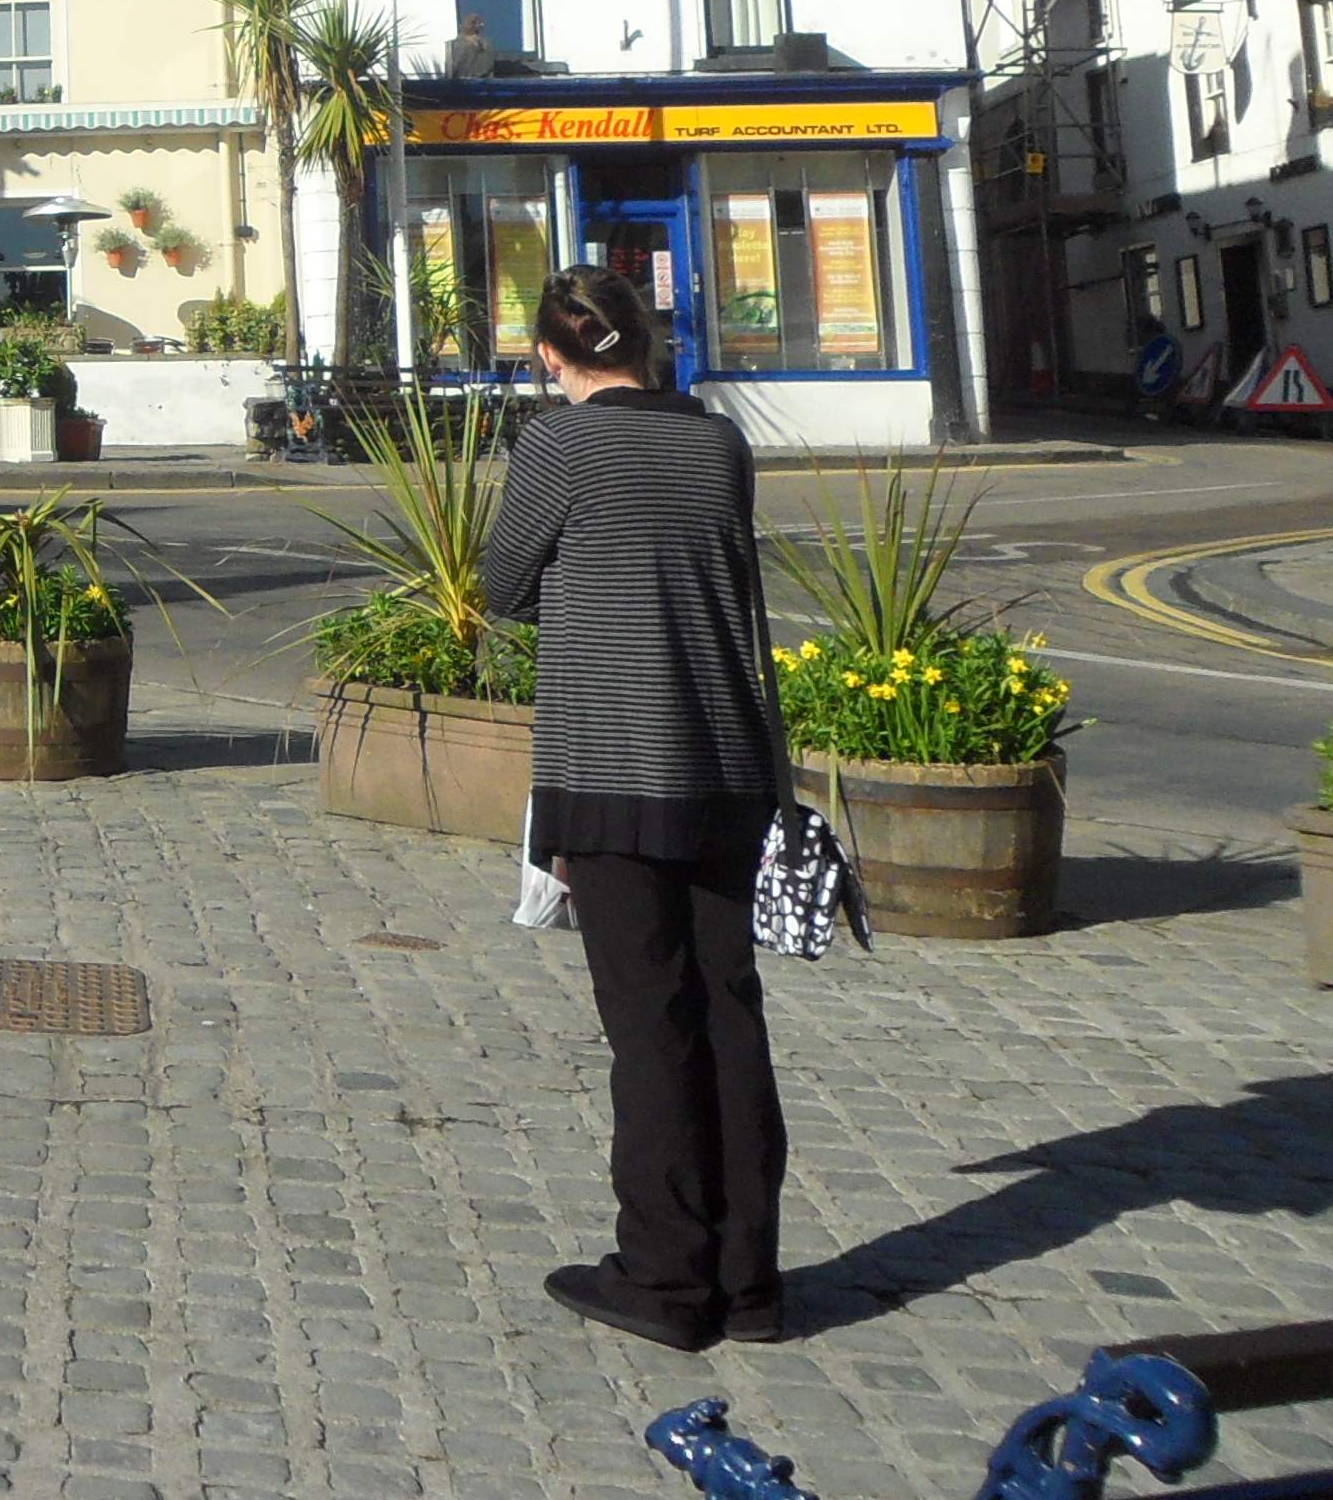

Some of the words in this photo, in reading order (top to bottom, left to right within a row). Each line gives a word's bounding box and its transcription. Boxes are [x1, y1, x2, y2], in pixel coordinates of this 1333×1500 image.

[441, 110, 523, 140] Chas.
[536, 108, 656, 140] Kendall
[674, 126, 721, 138] TURF
[732, 124, 855, 137] ACCOUNTANT
[866, 123, 903, 135] LTD.
